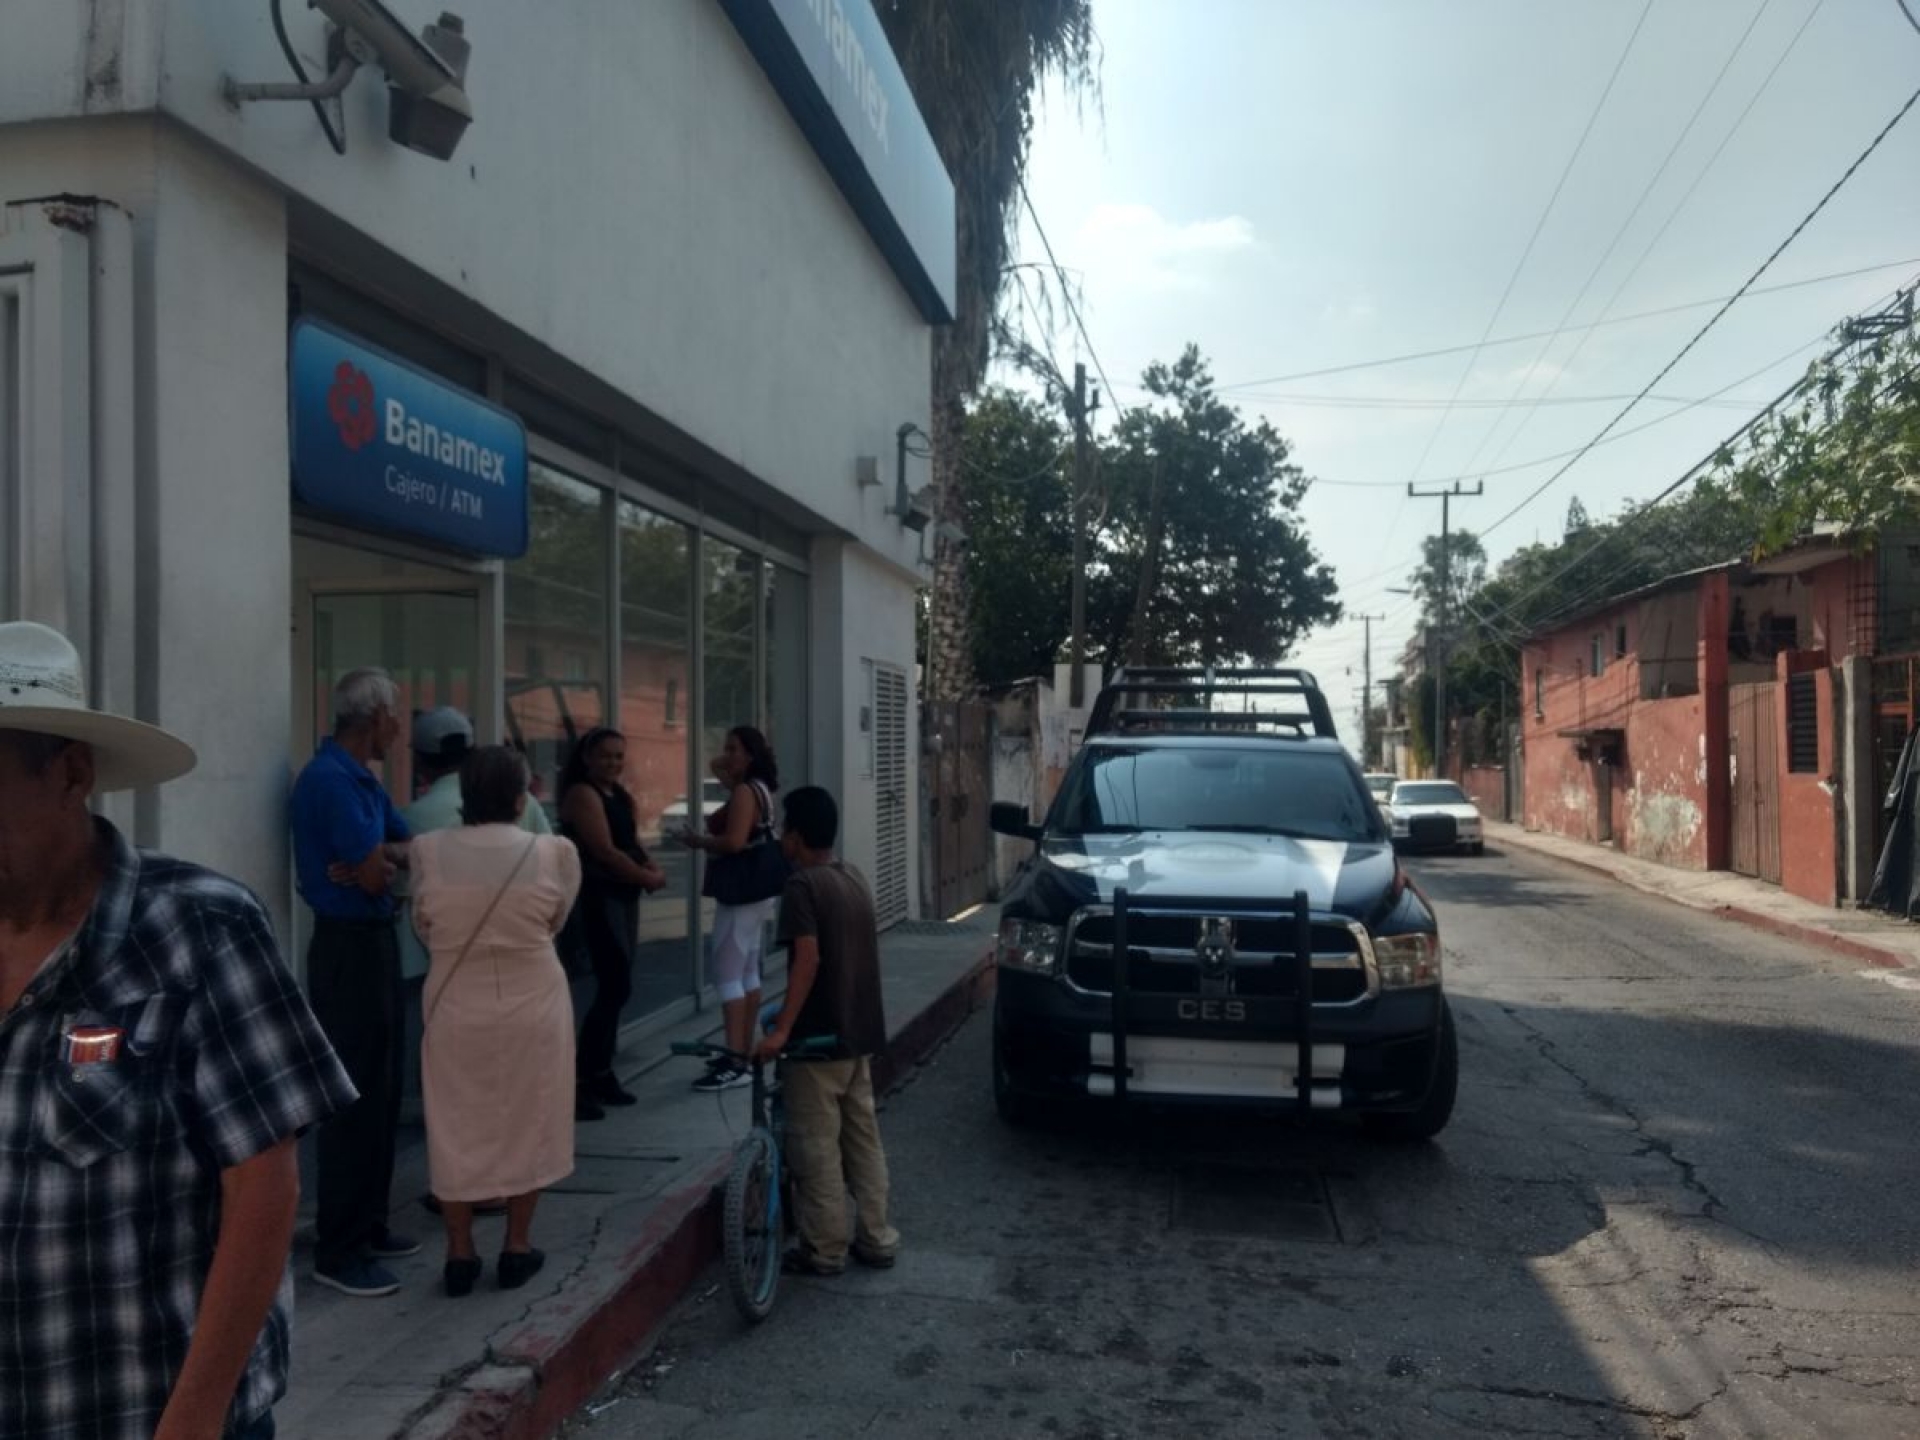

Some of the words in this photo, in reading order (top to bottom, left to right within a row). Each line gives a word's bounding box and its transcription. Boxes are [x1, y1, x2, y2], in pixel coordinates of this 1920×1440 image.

[386, 398, 505, 486] Banamex
[386, 464, 436, 504] Cajero
[440, 482, 448, 511] /
[451, 488, 482, 519] ATM
[1176, 998, 1247, 1021] CES
